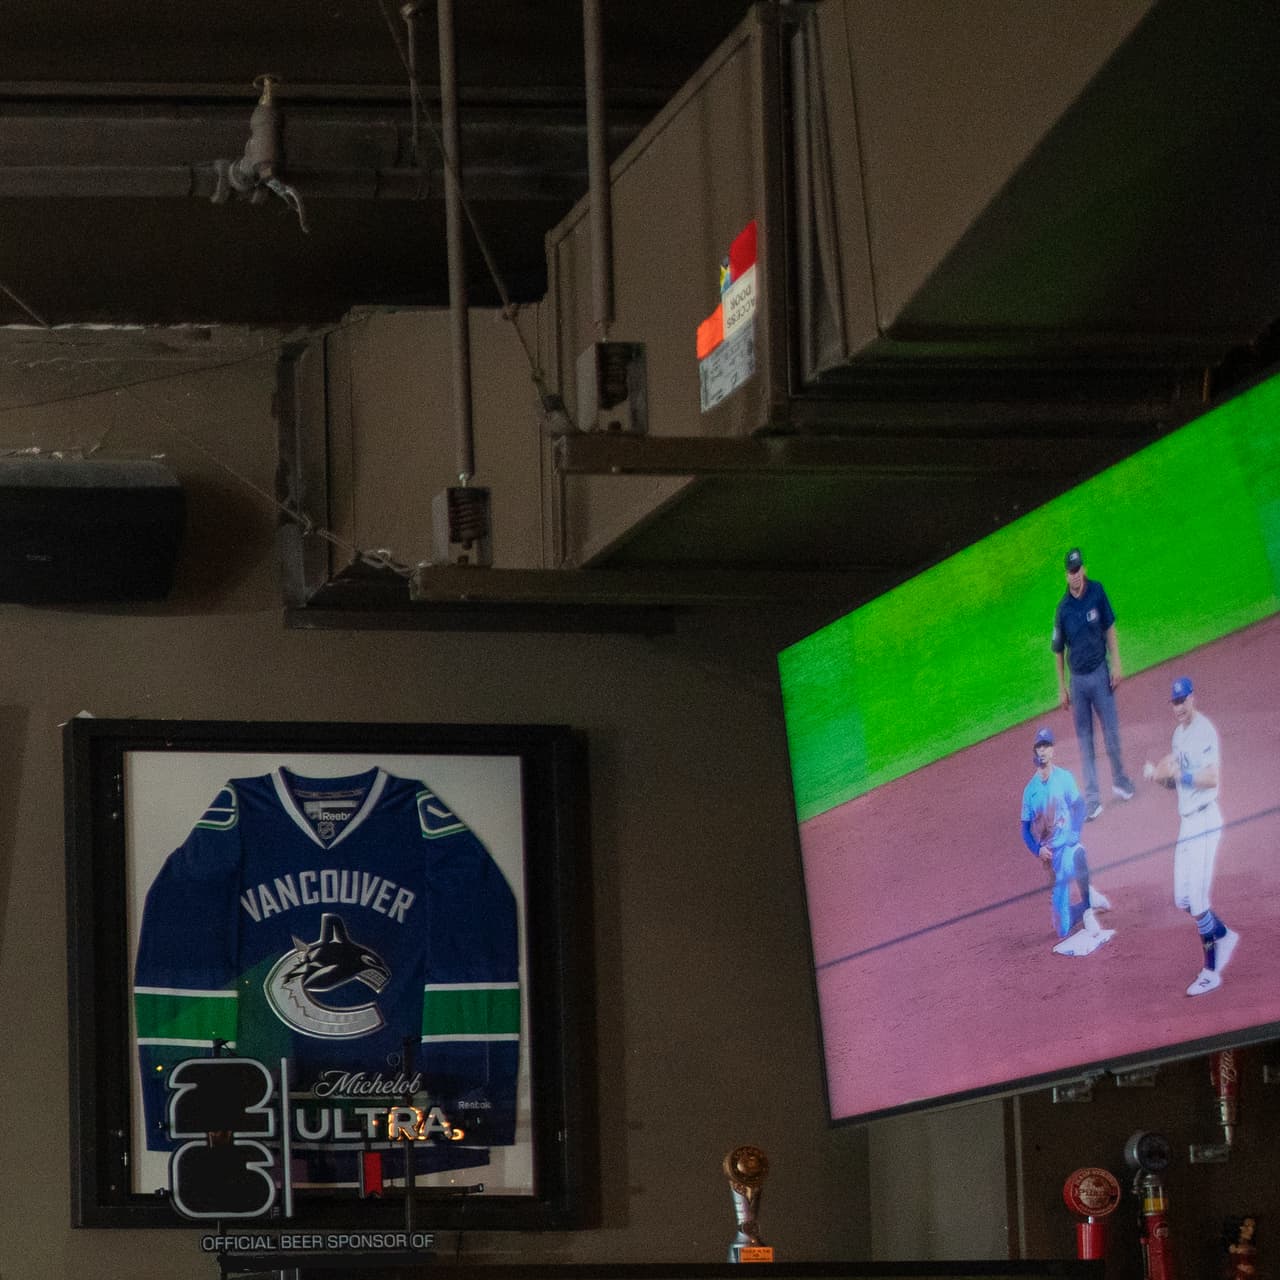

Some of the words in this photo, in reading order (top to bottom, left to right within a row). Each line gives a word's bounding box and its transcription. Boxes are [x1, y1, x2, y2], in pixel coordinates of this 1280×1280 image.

[240, 869, 416, 924] VANCOUVER
[313, 1069, 424, 1098] Michelob
[295, 1106, 454, 1141] ULTRA
[202, 1236, 276, 1251] OFFICIAL
[281, 1235, 323, 1250] BEER
[327, 1234, 407, 1250] SPONSOR
[411, 1234, 434, 1249] OF
